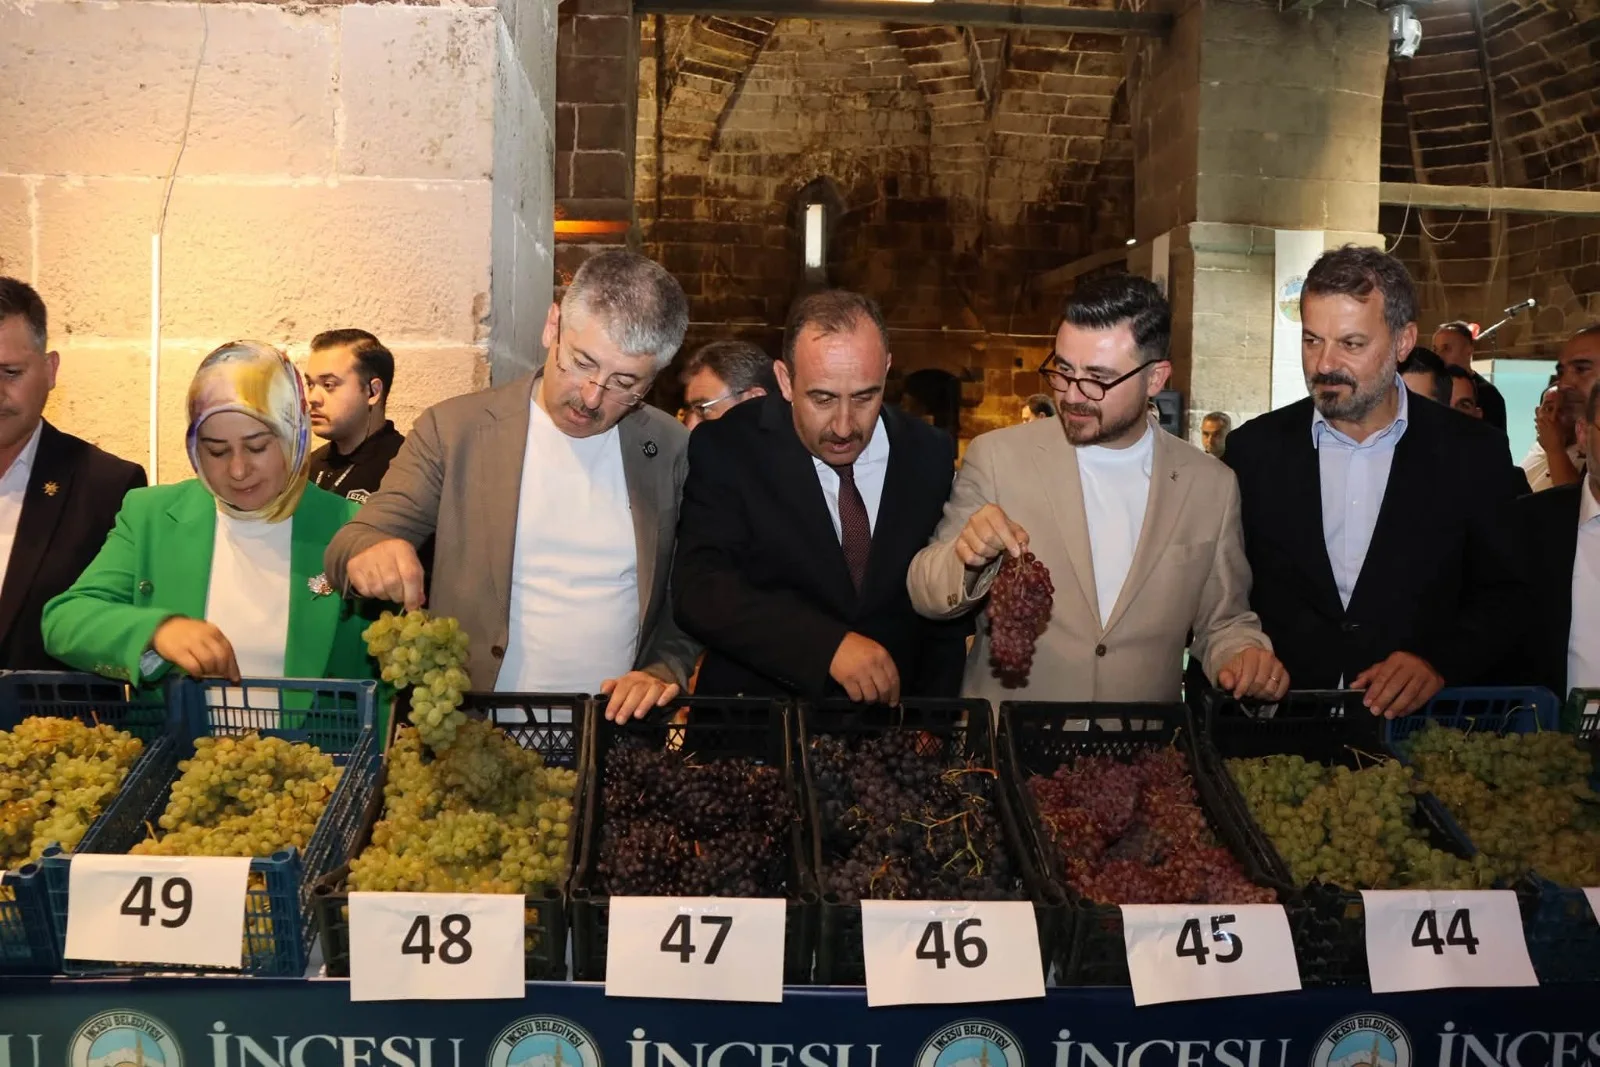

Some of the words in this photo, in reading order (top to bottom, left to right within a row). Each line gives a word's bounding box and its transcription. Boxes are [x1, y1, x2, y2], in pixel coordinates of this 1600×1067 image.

[121, 876, 193, 928] 49
[401, 913, 473, 965] 48
[660, 914, 733, 965] 47
[915, 918, 988, 969] 46
[1175, 914, 1243, 966] 45
[1411, 908, 1480, 956] 44
[207, 1020, 464, 1067] İNCESU
[626, 1027, 882, 1067] İNCESU
[1052, 1028, 1292, 1067] İNCESU
